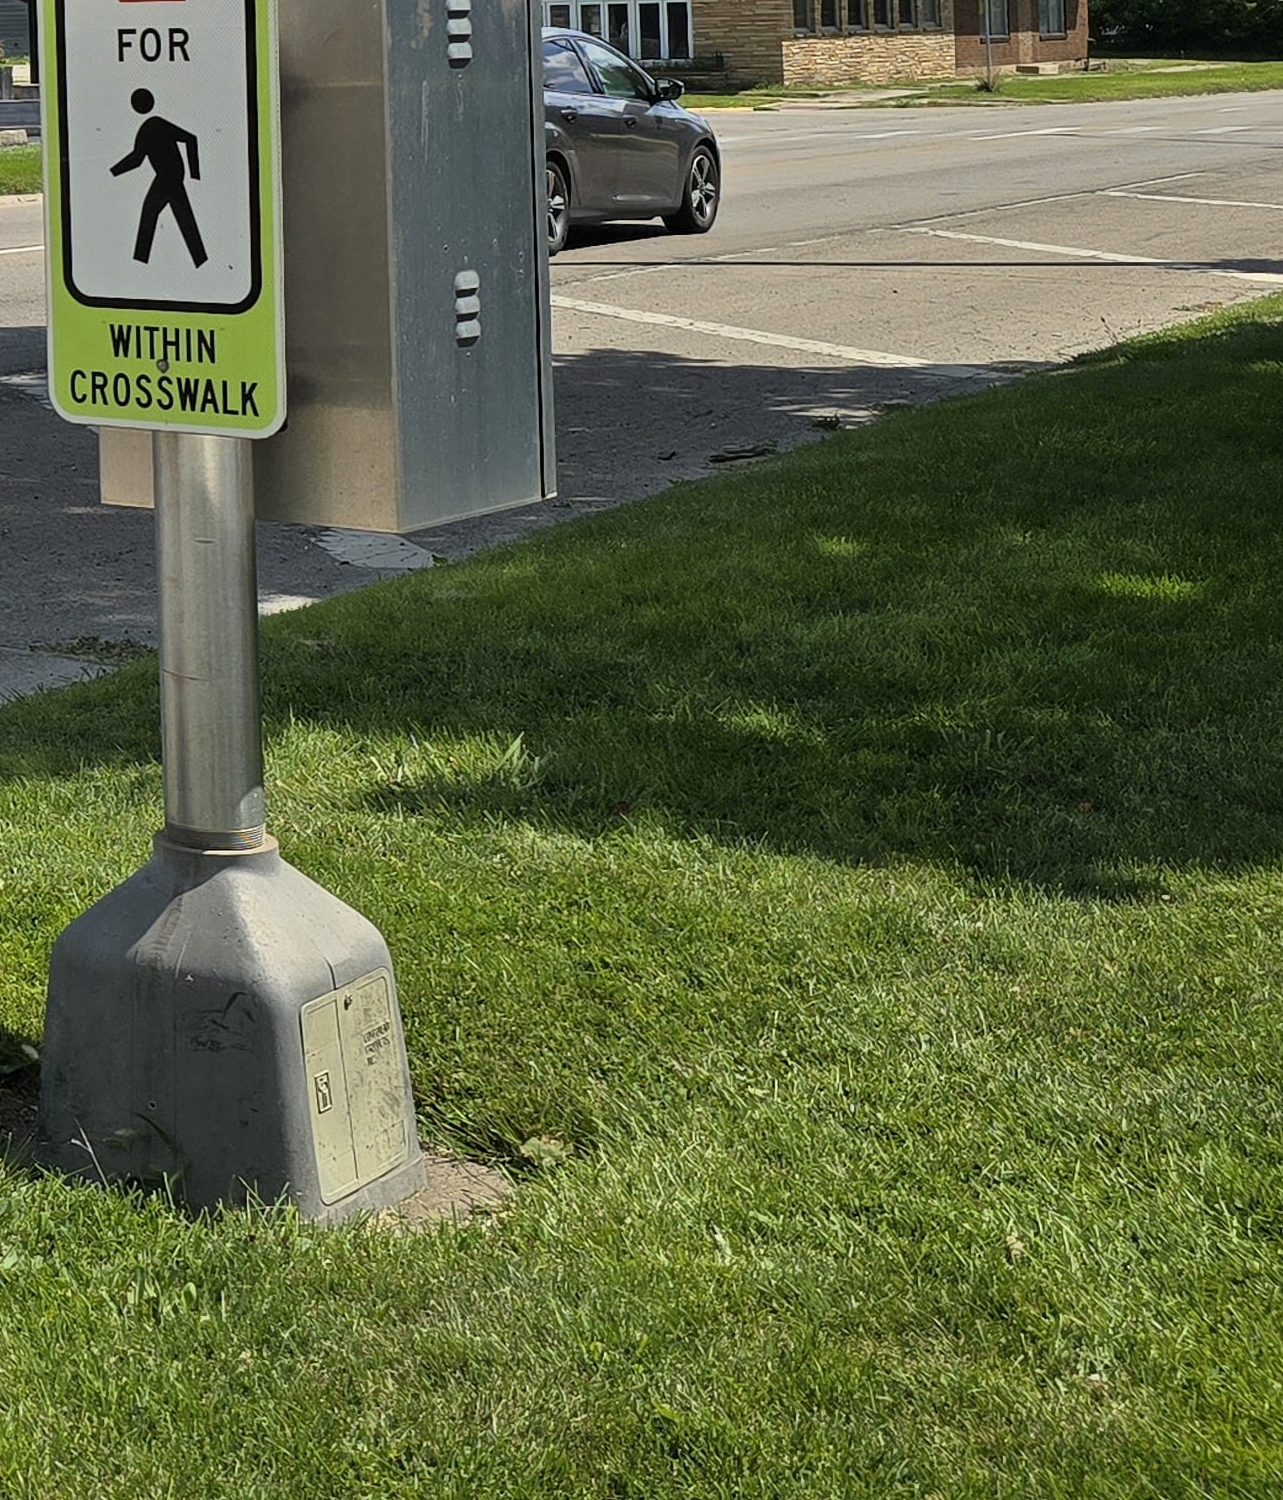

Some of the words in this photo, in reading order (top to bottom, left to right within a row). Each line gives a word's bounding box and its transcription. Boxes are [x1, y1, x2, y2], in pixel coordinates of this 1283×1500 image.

[117, 28, 191, 62] FOR
[109, 323, 217, 364] WITHIN
[70, 369, 259, 417] CROSSWALK
